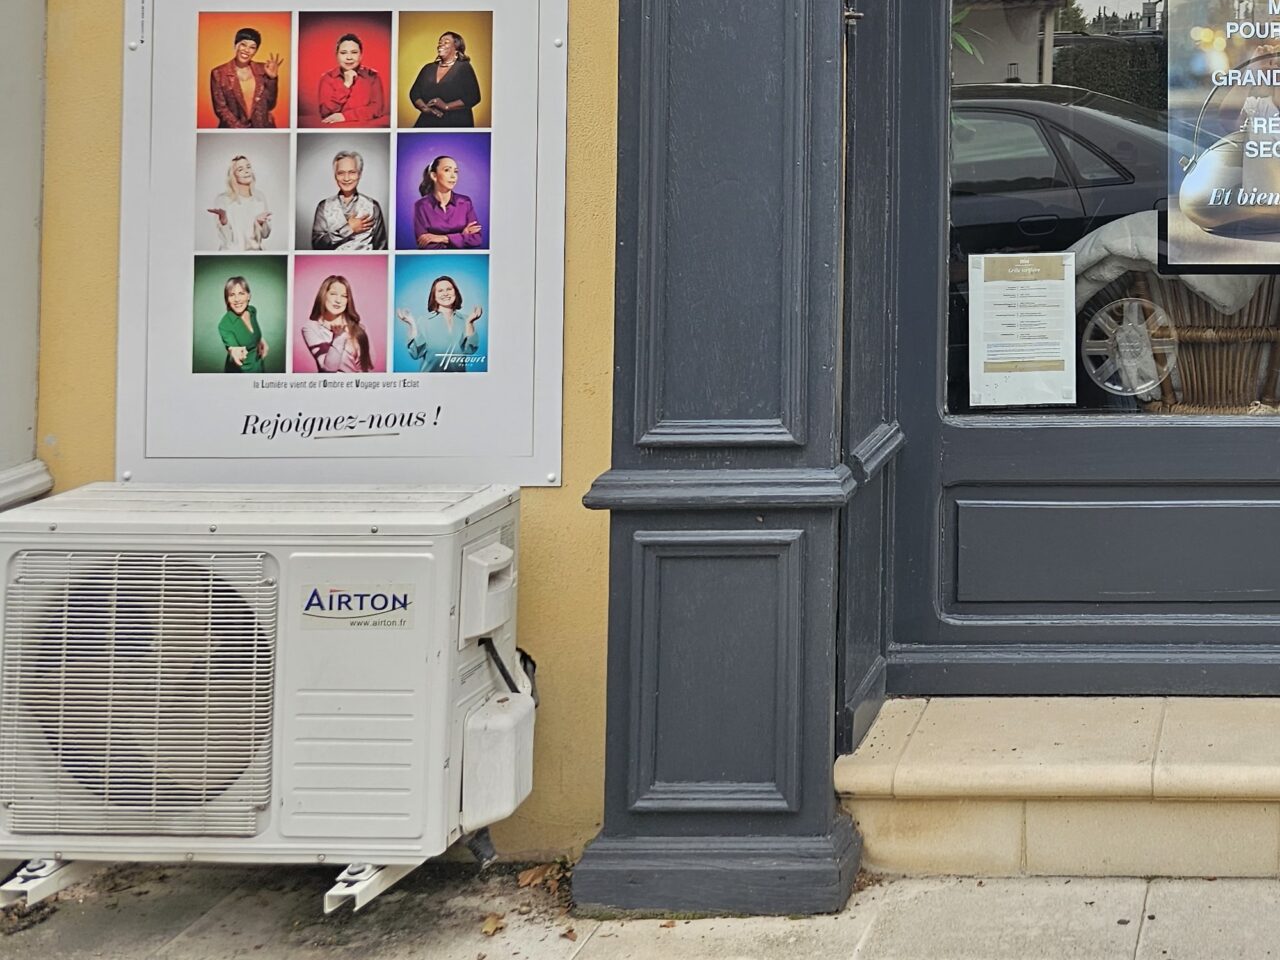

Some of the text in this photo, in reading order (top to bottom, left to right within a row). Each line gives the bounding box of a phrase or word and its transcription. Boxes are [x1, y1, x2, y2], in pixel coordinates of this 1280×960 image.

[1208, 189, 1233, 206] Et
[435, 343, 486, 370] Harcourt
[240, 406, 442, 440] Rejoignez-nous !
[349, 618, 407, 628] www.airton.fr
